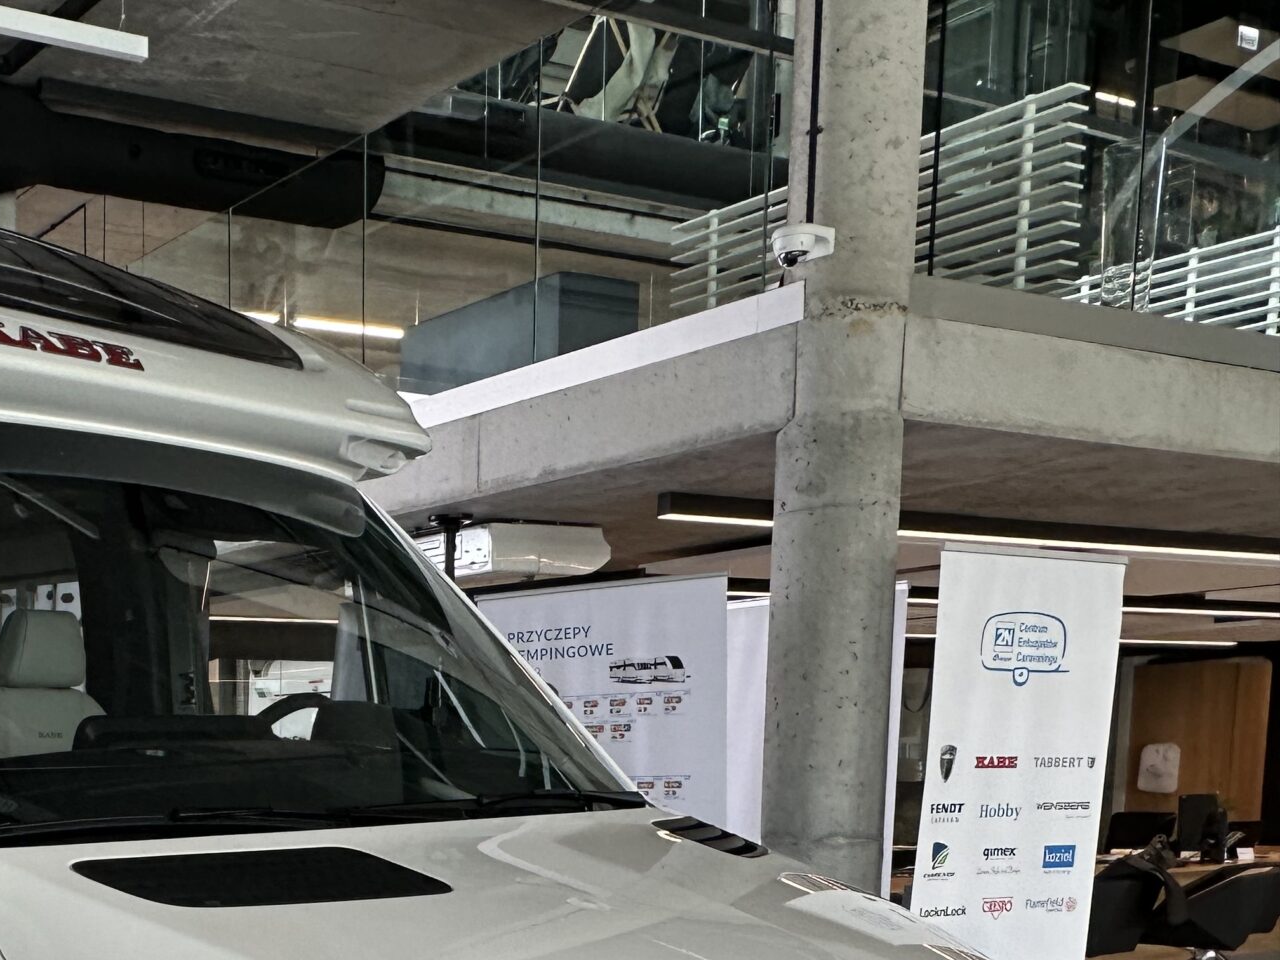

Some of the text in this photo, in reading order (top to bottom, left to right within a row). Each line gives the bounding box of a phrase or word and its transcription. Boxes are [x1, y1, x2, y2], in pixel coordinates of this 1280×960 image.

[508, 626, 591, 643] PRZYCZEPY
[518, 643, 614, 661] EMPINGOWE
[975, 757, 1018, 769] KABE
[1034, 757, 1083, 768] TABBERT
[930, 803, 965, 814] FENDT
[979, 803, 1022, 820] Hobby
[982, 847, 1017, 861] gimex
[919, 905, 967, 918] LocknLock
